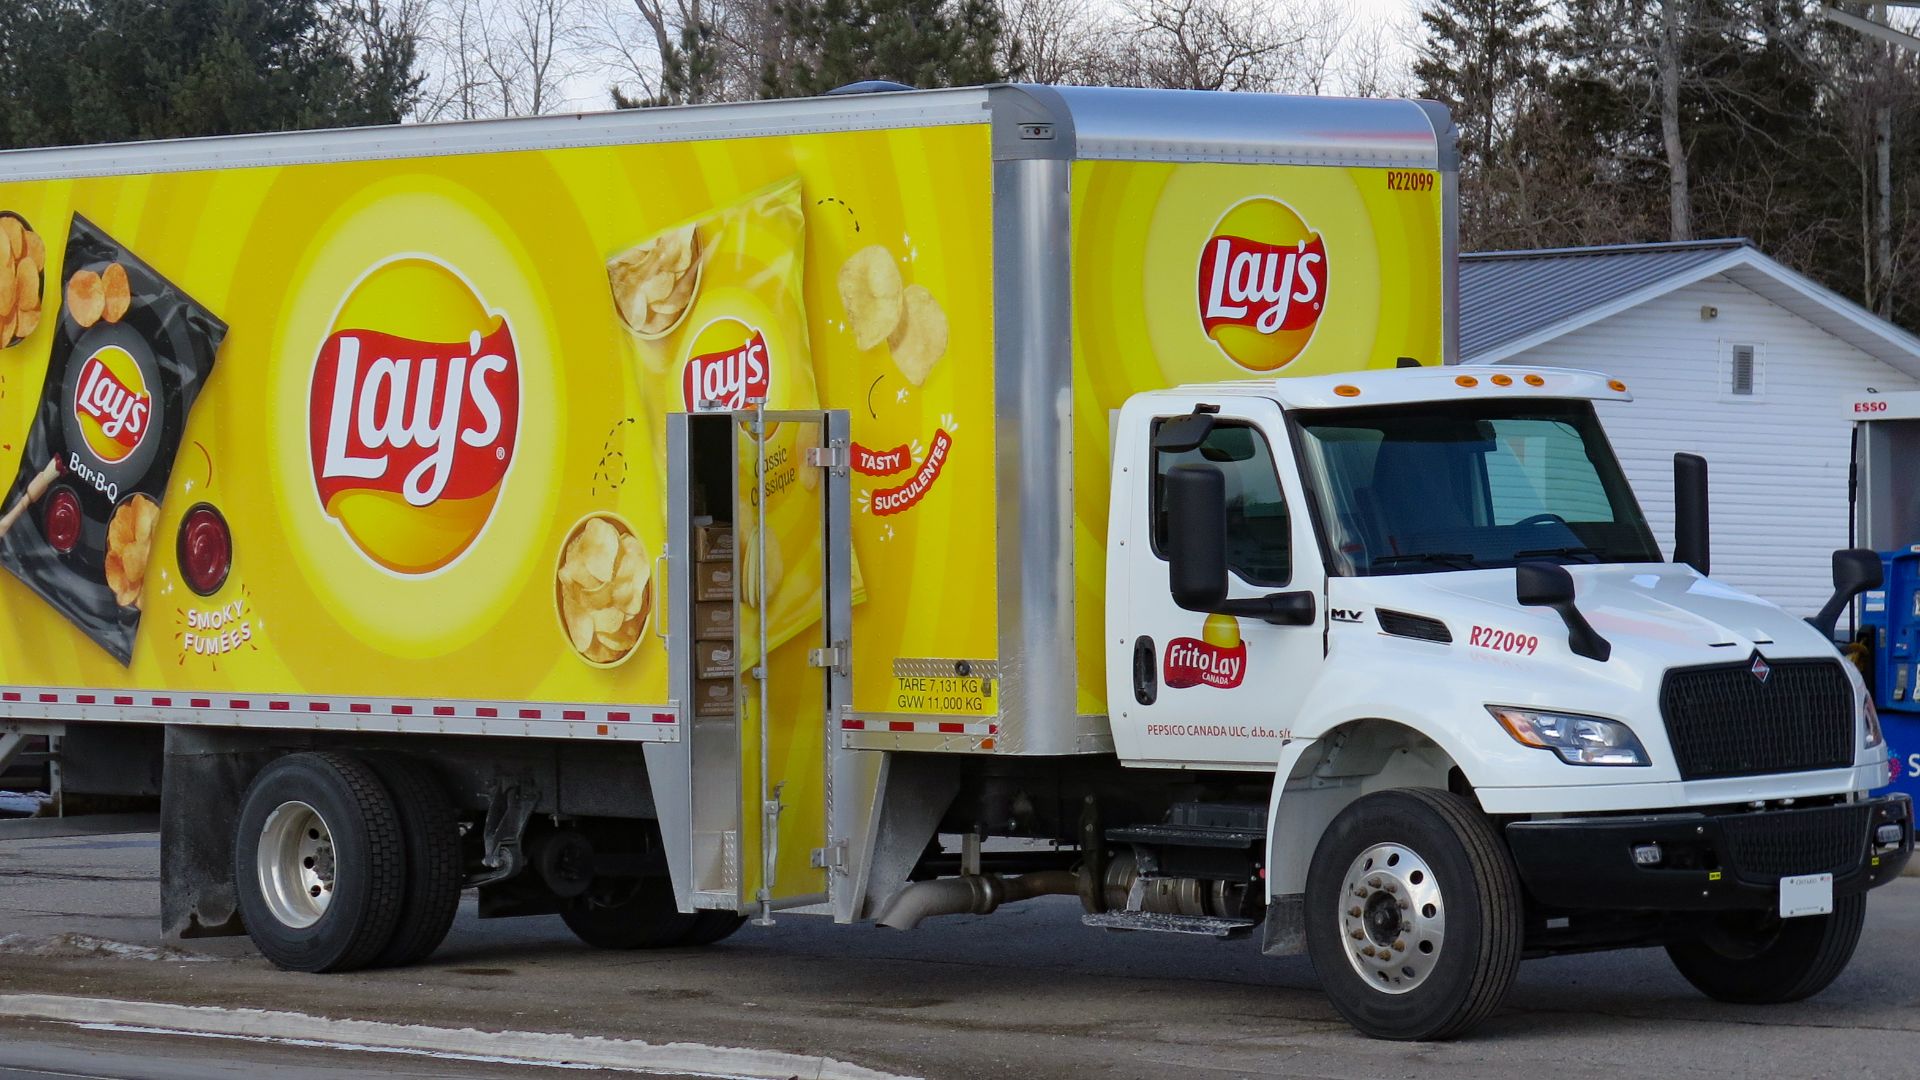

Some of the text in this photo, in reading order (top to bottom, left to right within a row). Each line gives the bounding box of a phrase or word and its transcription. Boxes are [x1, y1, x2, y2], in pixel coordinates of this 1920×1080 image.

[1387, 171, 1434, 192] R22099
[1206, 239, 1321, 335] Lay's
[78, 361, 147, 438] Lay's
[1854, 401, 1888, 413] ESSO
[322, 330, 508, 507] Lay's
[754, 445, 788, 479] Cassic
[860, 452, 901, 471] TASTY
[874, 436, 948, 511] SUCCULENTES
[750, 467, 796, 508] Cssique
[187, 599, 244, 632] SMOKY
[1331, 608, 1364, 620] MV
[184, 621, 252, 657] FUMÉES
[1469, 625, 1539, 656] R22099
[898, 677, 978, 693] TARE 7,131 KG
[1201, 671, 1229, 685] CANADA
[897, 694, 983, 711] GVW 11,000 KG
[1147, 724, 1185, 736] PEPSICO
[1187, 725, 1228, 737] CANADA
[1228, 726, 1250, 739] ULC,
